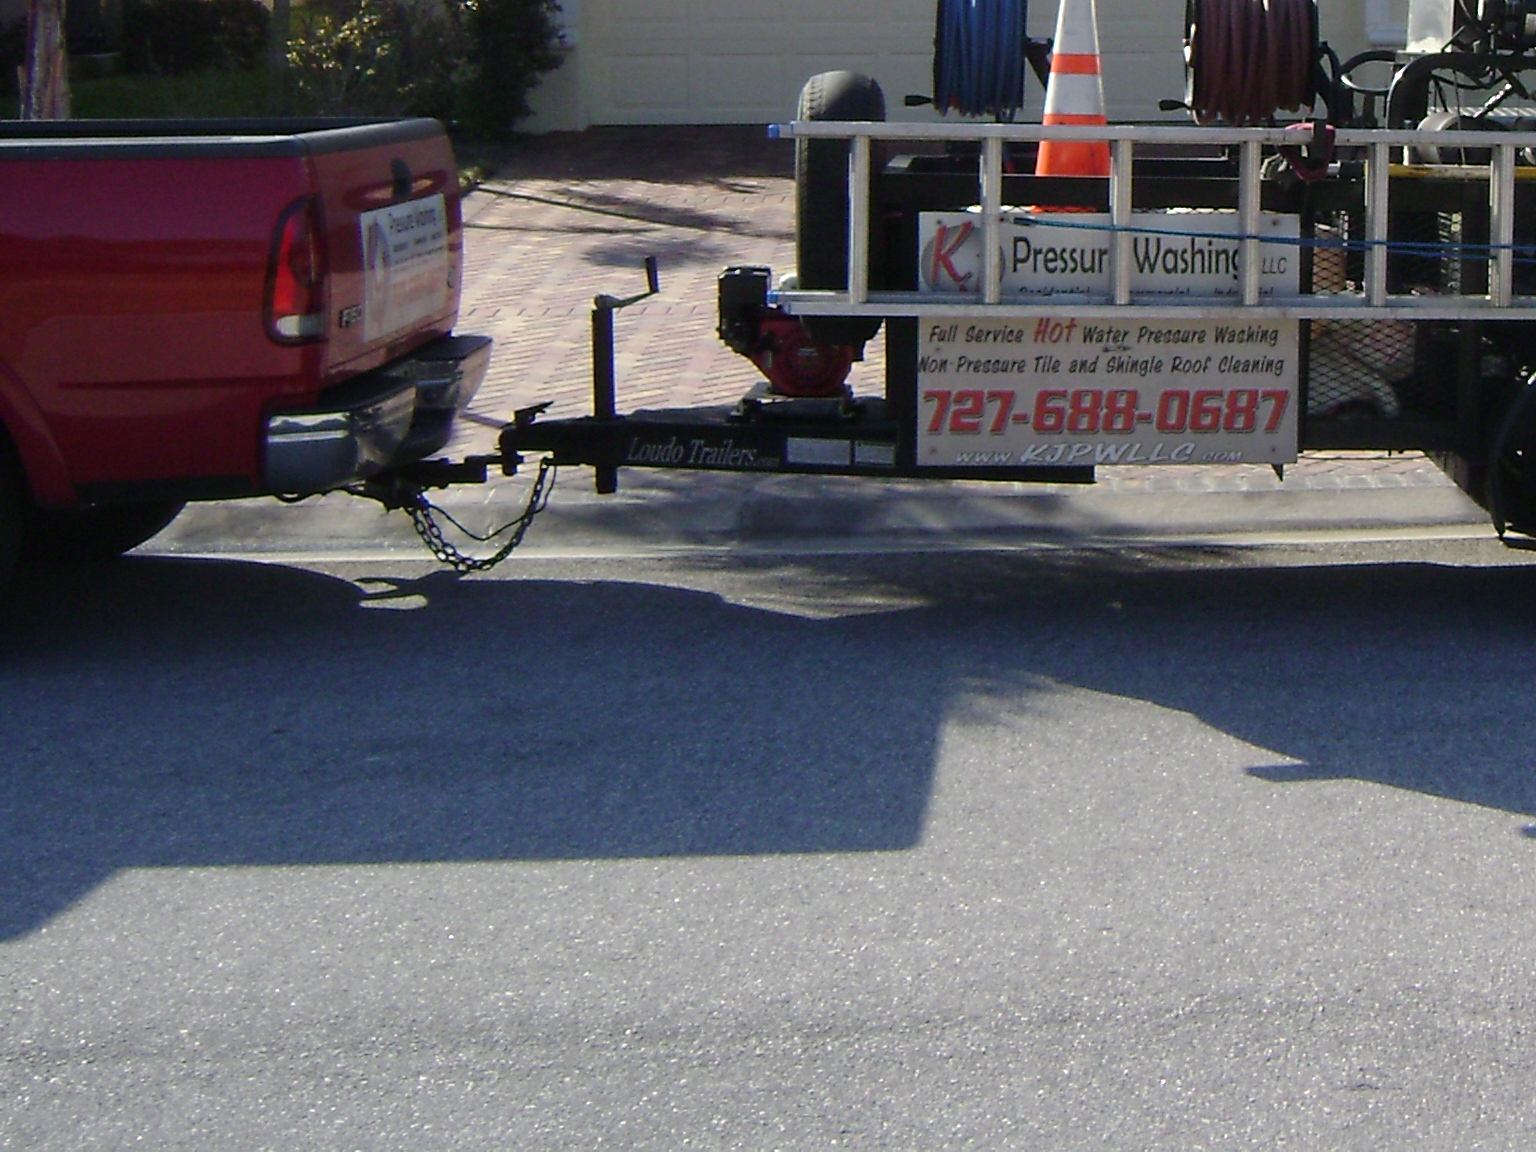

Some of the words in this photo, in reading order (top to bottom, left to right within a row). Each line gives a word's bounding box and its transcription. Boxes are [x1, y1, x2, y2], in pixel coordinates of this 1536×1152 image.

[1011, 235, 1109, 274] Pressur
[1261, 256, 1288, 274] LLC
[929, 324, 958, 343] Full
[965, 324, 1024, 343] Service
[1082, 325, 1130, 344] Water
[1137, 325, 1207, 344] Pressure
[1215, 325, 1279, 347] Washing
[1034, 354, 1062, 374] Tile
[1068, 355, 1100, 374] and
[1106, 355, 1164, 377] Shingle
[1170, 355, 1213, 374] Roof
[1218, 355, 1285, 377] Cleaning
[923, 389, 1290, 435] 727-688-0687
